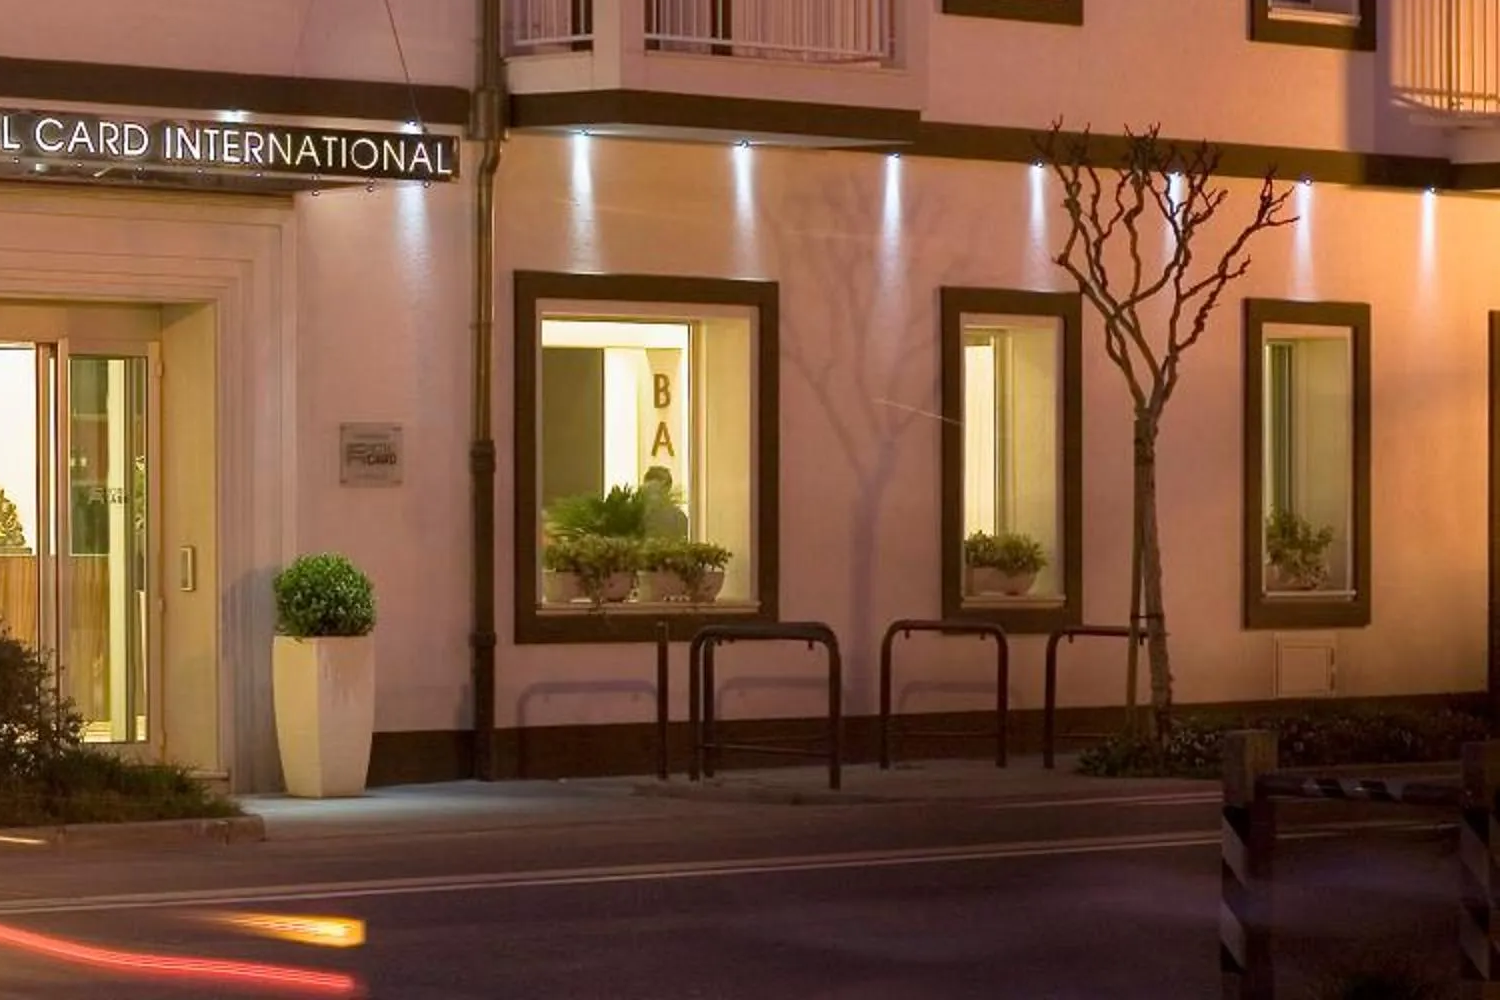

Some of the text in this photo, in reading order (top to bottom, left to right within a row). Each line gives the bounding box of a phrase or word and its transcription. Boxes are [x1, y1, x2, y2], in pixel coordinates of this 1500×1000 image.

[34, 117, 150, 157] CARD
[163, 125, 454, 175] INTERNATIONAL
[650, 373, 675, 457] BA
